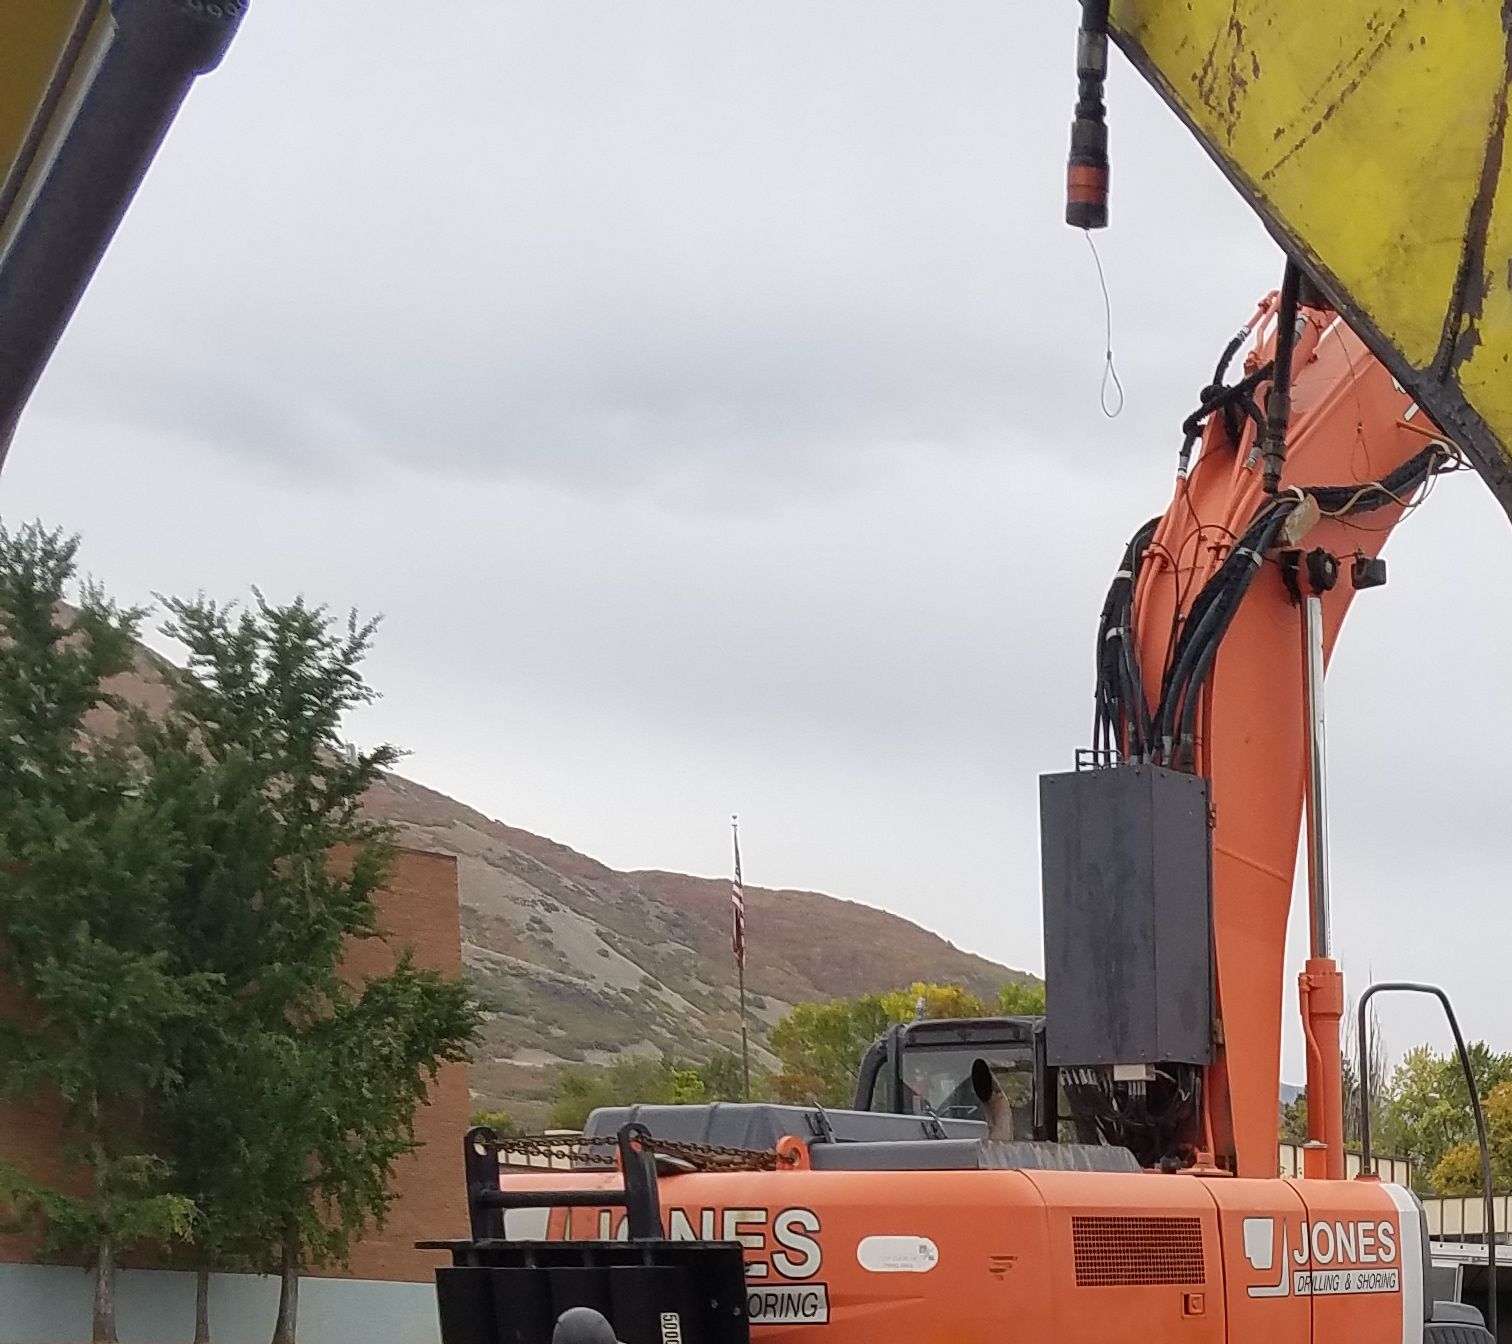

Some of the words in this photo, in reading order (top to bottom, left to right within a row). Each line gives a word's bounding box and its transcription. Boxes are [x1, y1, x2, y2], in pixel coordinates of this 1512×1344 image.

[1294, 1221, 1396, 1264] JONES
[1297, 1274, 1340, 1292] DRILLING
[1345, 1273, 1351, 1291] &
[1356, 1272, 1396, 1289] SHORING
[748, 1292, 818, 1318] ORING
